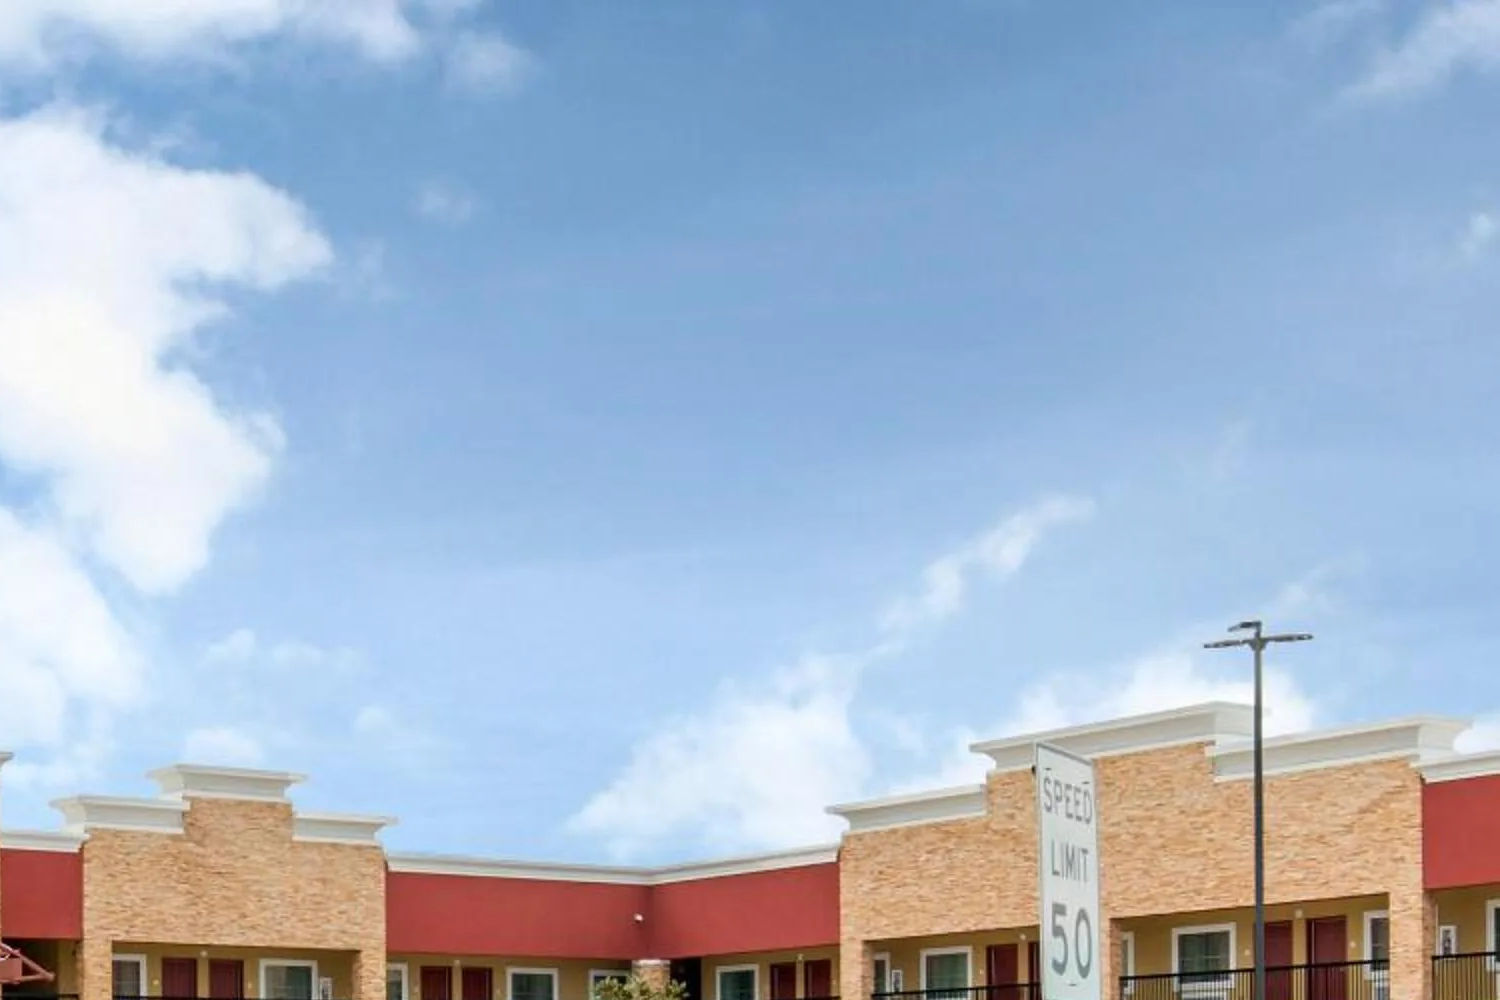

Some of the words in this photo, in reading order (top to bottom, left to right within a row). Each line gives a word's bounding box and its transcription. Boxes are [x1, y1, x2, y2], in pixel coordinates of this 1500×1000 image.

[1042, 776, 1093, 825] SPEED
[1051, 838, 1089, 883] LIMIT
[1051, 902, 1092, 979] 50
